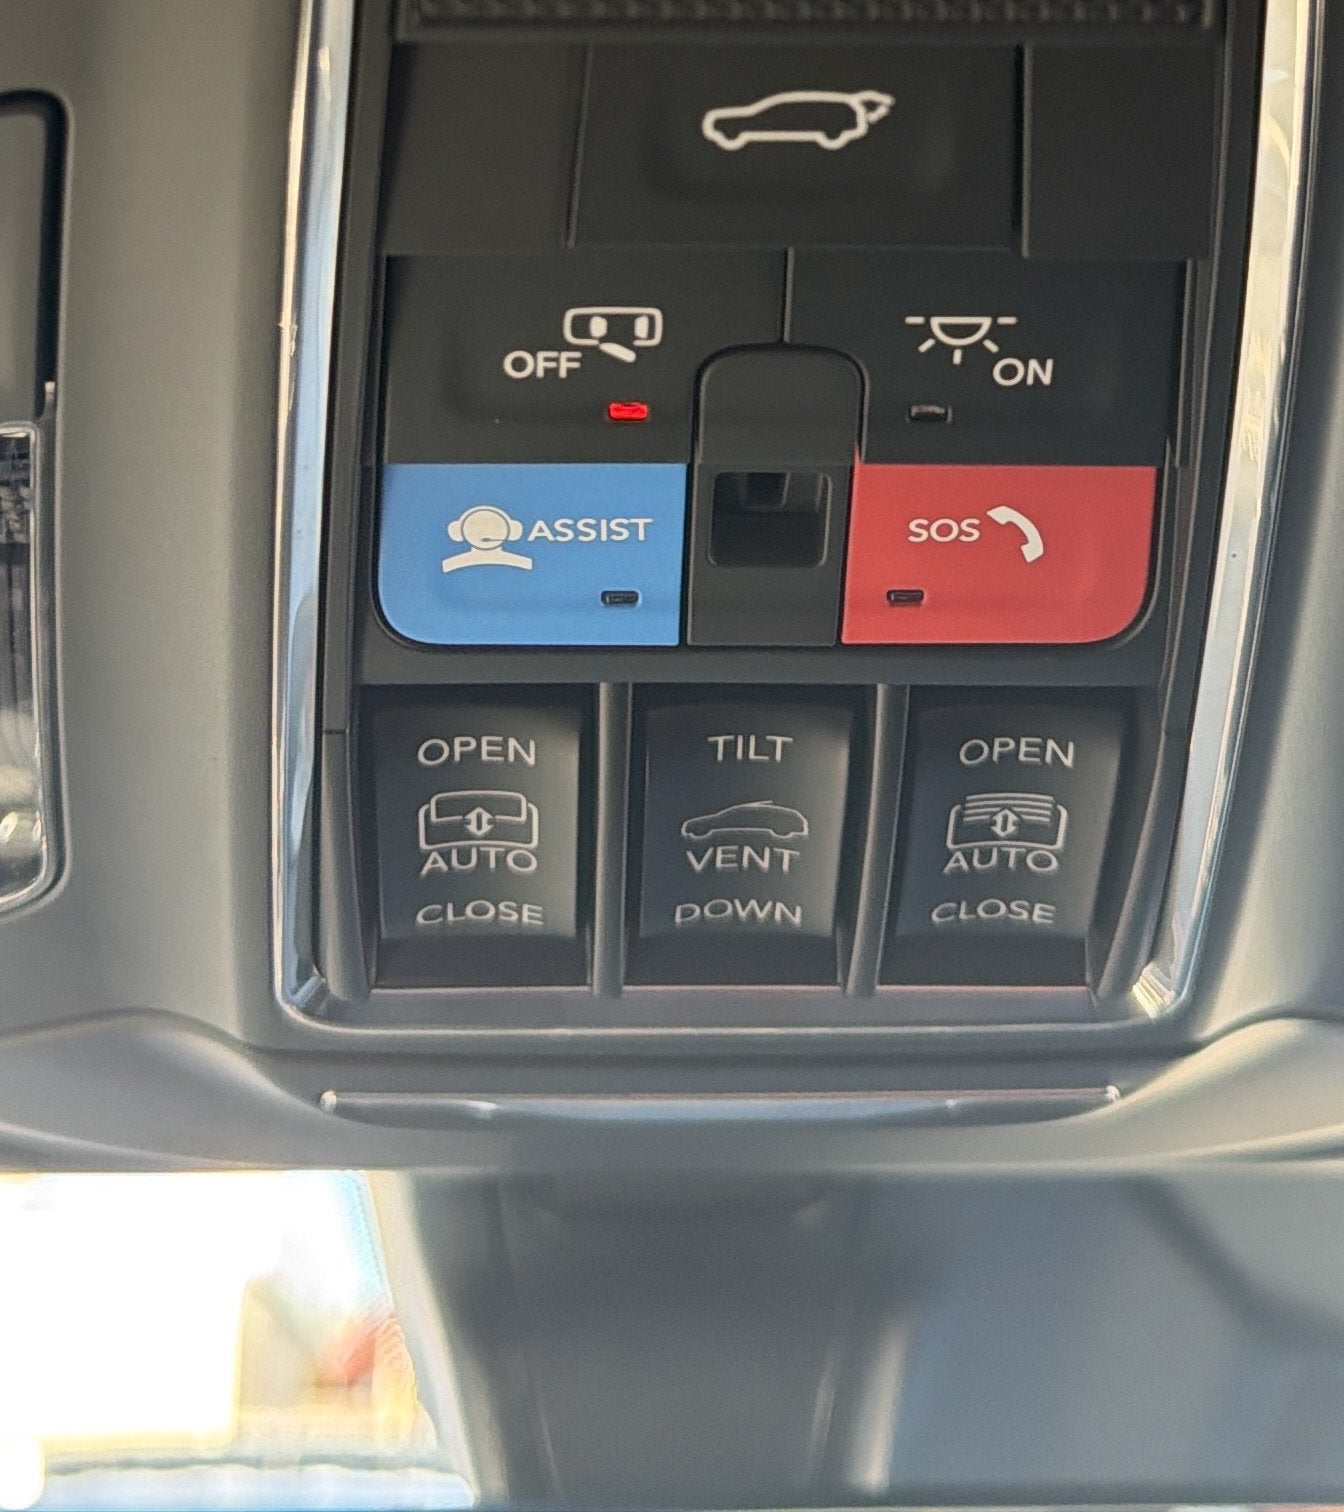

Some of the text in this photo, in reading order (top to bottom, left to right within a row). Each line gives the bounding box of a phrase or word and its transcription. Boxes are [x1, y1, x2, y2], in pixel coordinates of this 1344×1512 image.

[503, 351, 582, 379] OFF
[992, 358, 1054, 387] ON
[528, 517, 654, 543] ASSIST
[907, 517, 980, 543] SOS
[417, 735, 536, 765] OPEN
[707, 734, 793, 763] TILT
[958, 736, 1075, 767] OPEN
[419, 847, 539, 876] AUTO
[685, 845, 801, 874] VENT
[943, 846, 1059, 876] AUTO
[415, 899, 544, 927] CLOSE
[674, 899, 803, 927] DOWN
[930, 898, 1056, 927] CLOSE
